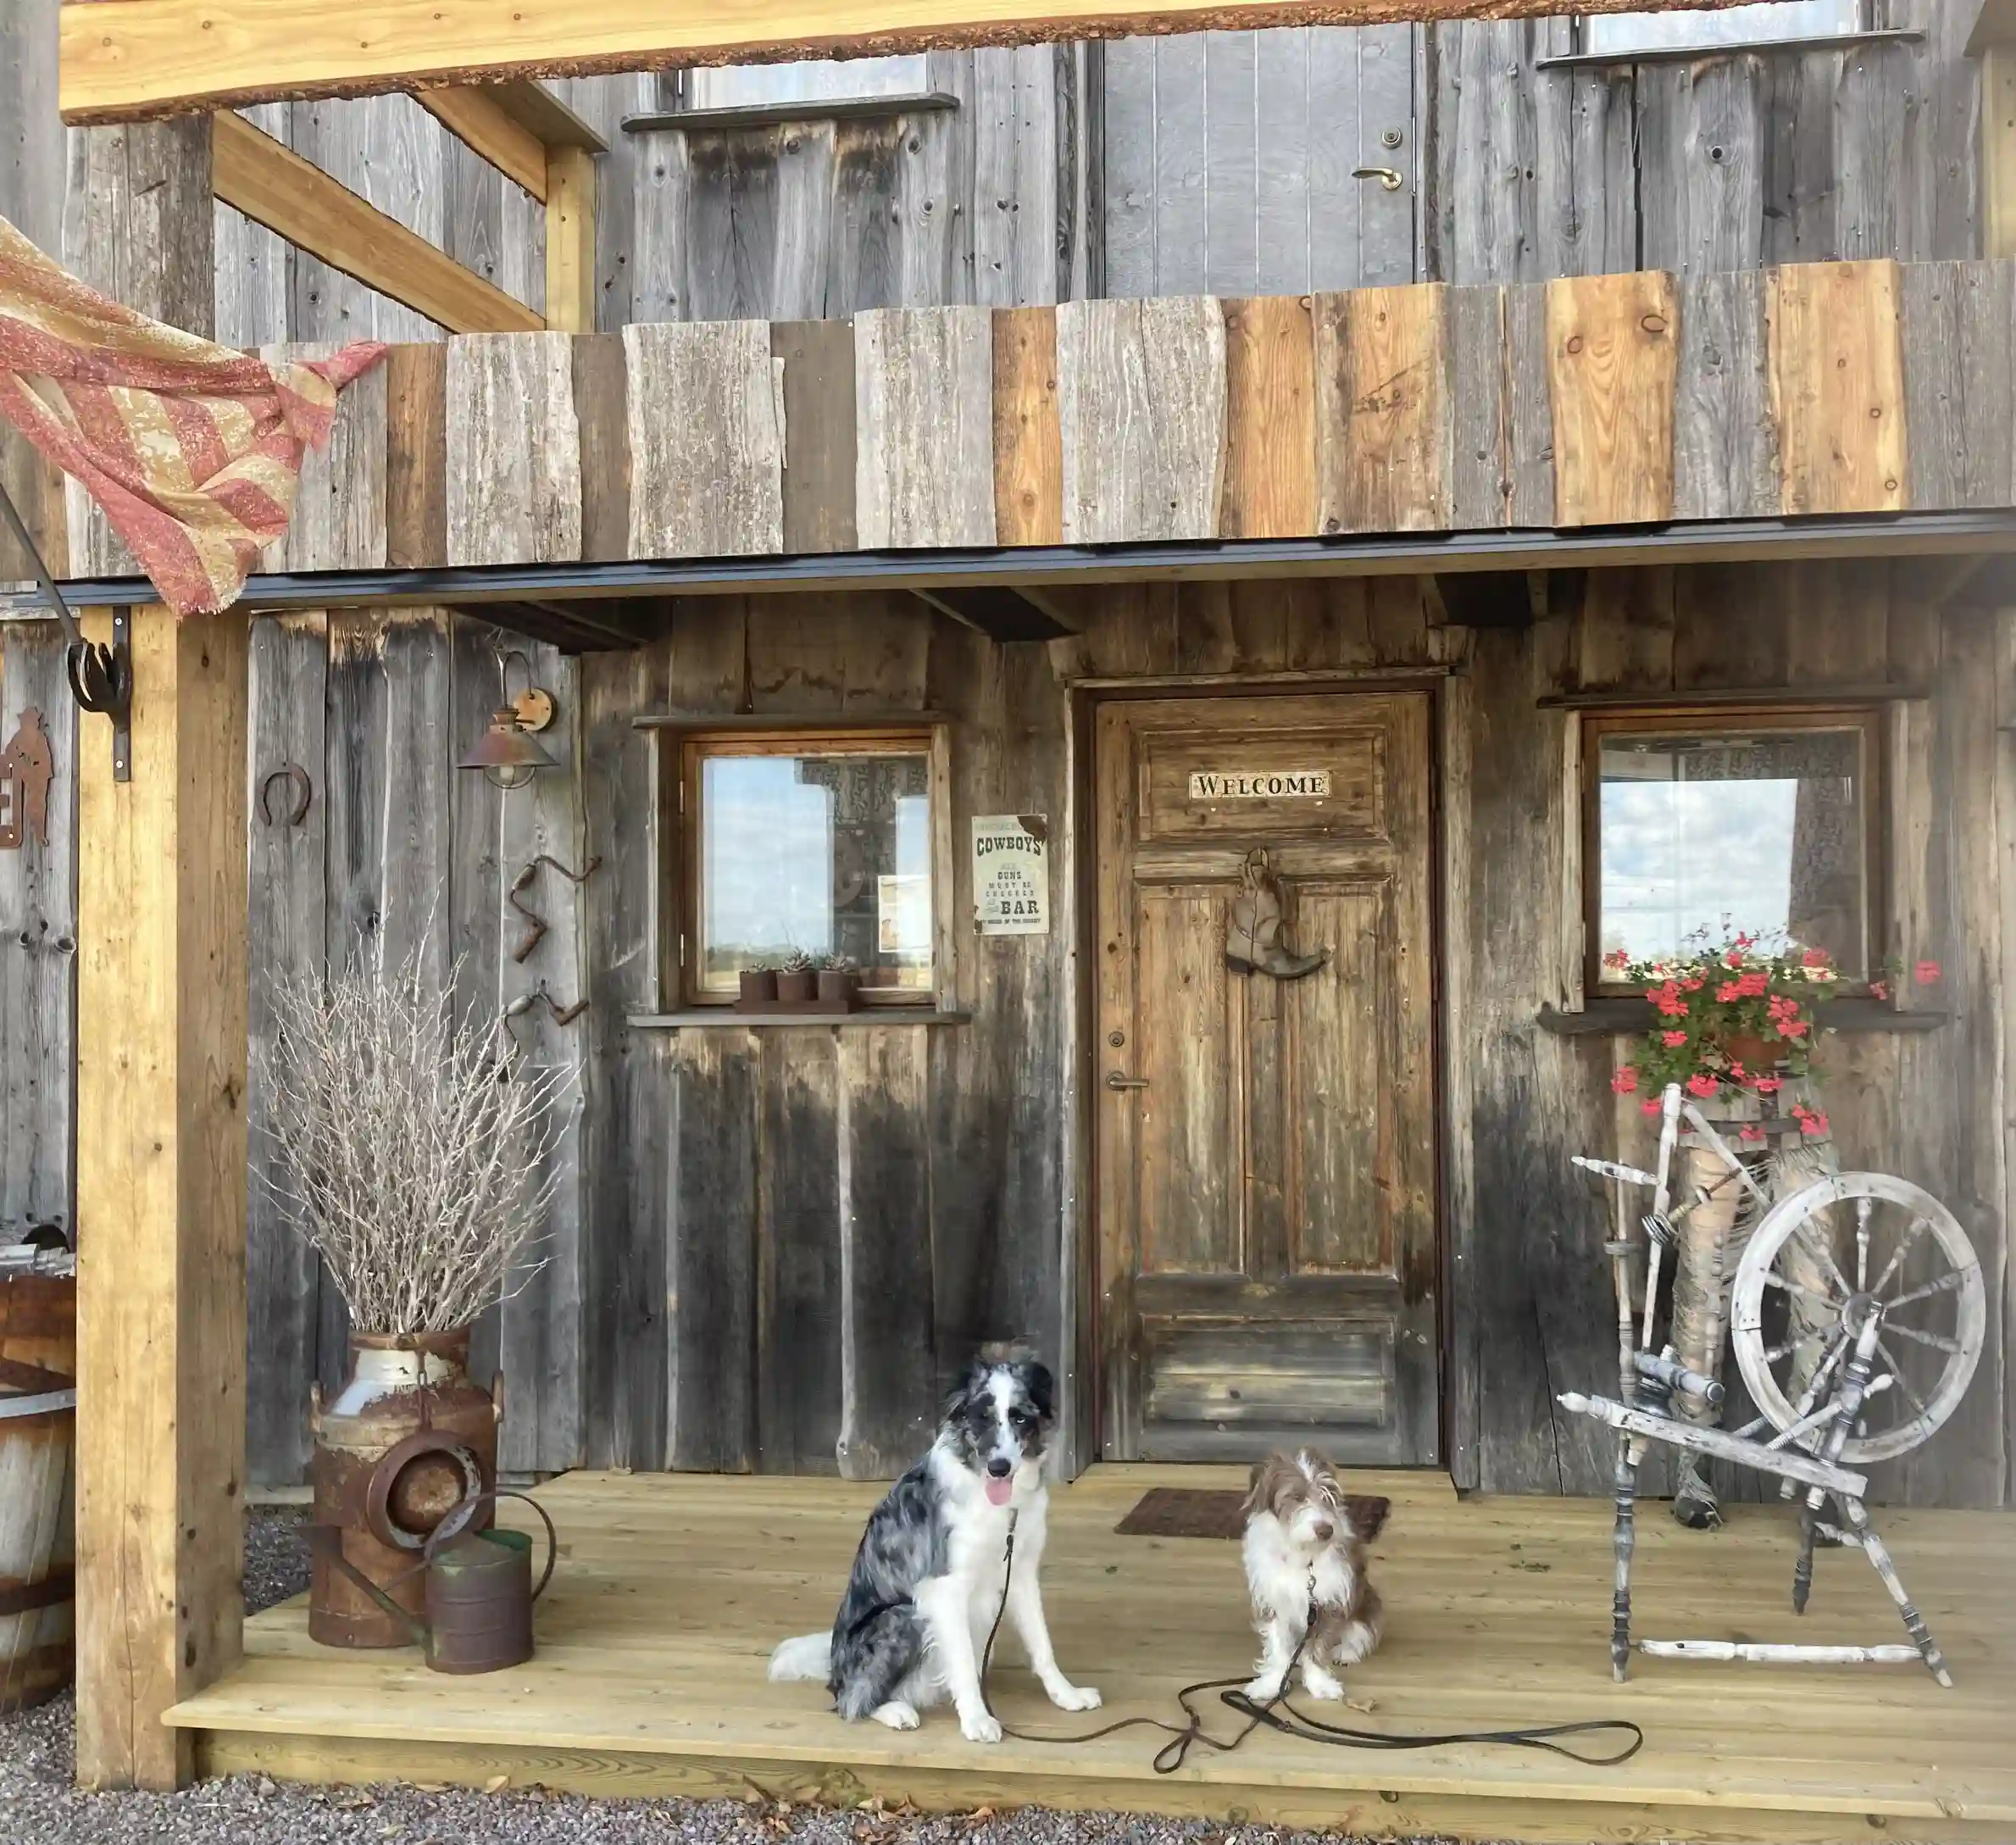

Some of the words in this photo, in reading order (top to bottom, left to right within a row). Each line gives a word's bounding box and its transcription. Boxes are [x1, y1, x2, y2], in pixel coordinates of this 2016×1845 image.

[1197, 775, 1325, 797] WELCOME
[976, 836, 1041, 857] COWBOYS
[1000, 900, 1040, 915] BAR
